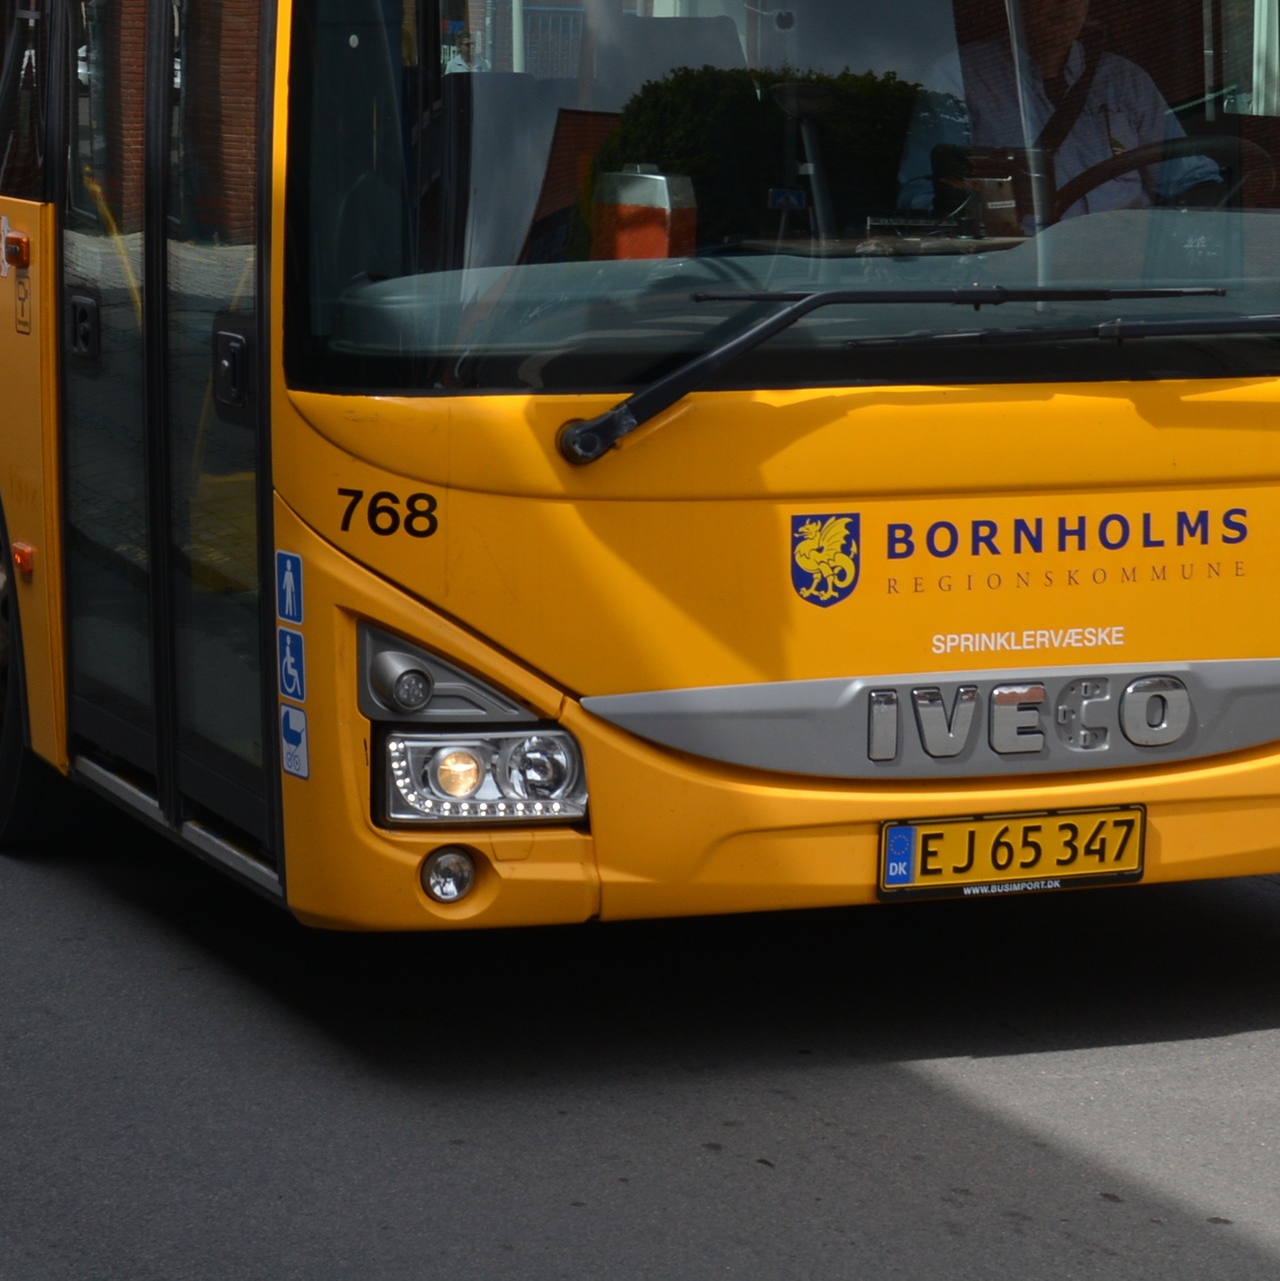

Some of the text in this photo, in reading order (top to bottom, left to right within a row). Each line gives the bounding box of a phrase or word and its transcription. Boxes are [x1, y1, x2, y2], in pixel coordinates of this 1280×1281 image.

[337, 487, 438, 538] 768
[886, 508, 1249, 560] BORNHOLMS
[886, 561, 1247, 595] REGIONSKOMMUNE
[931, 627, 1125, 654] SPRINKLERVÆSKE
[867, 674, 1192, 762] IVECO
[920, 818, 1136, 876] EJ 65 347
[888, 861, 908, 877] DK
[963, 879, 1061, 897] WWW.BUSIMPORT.DK
